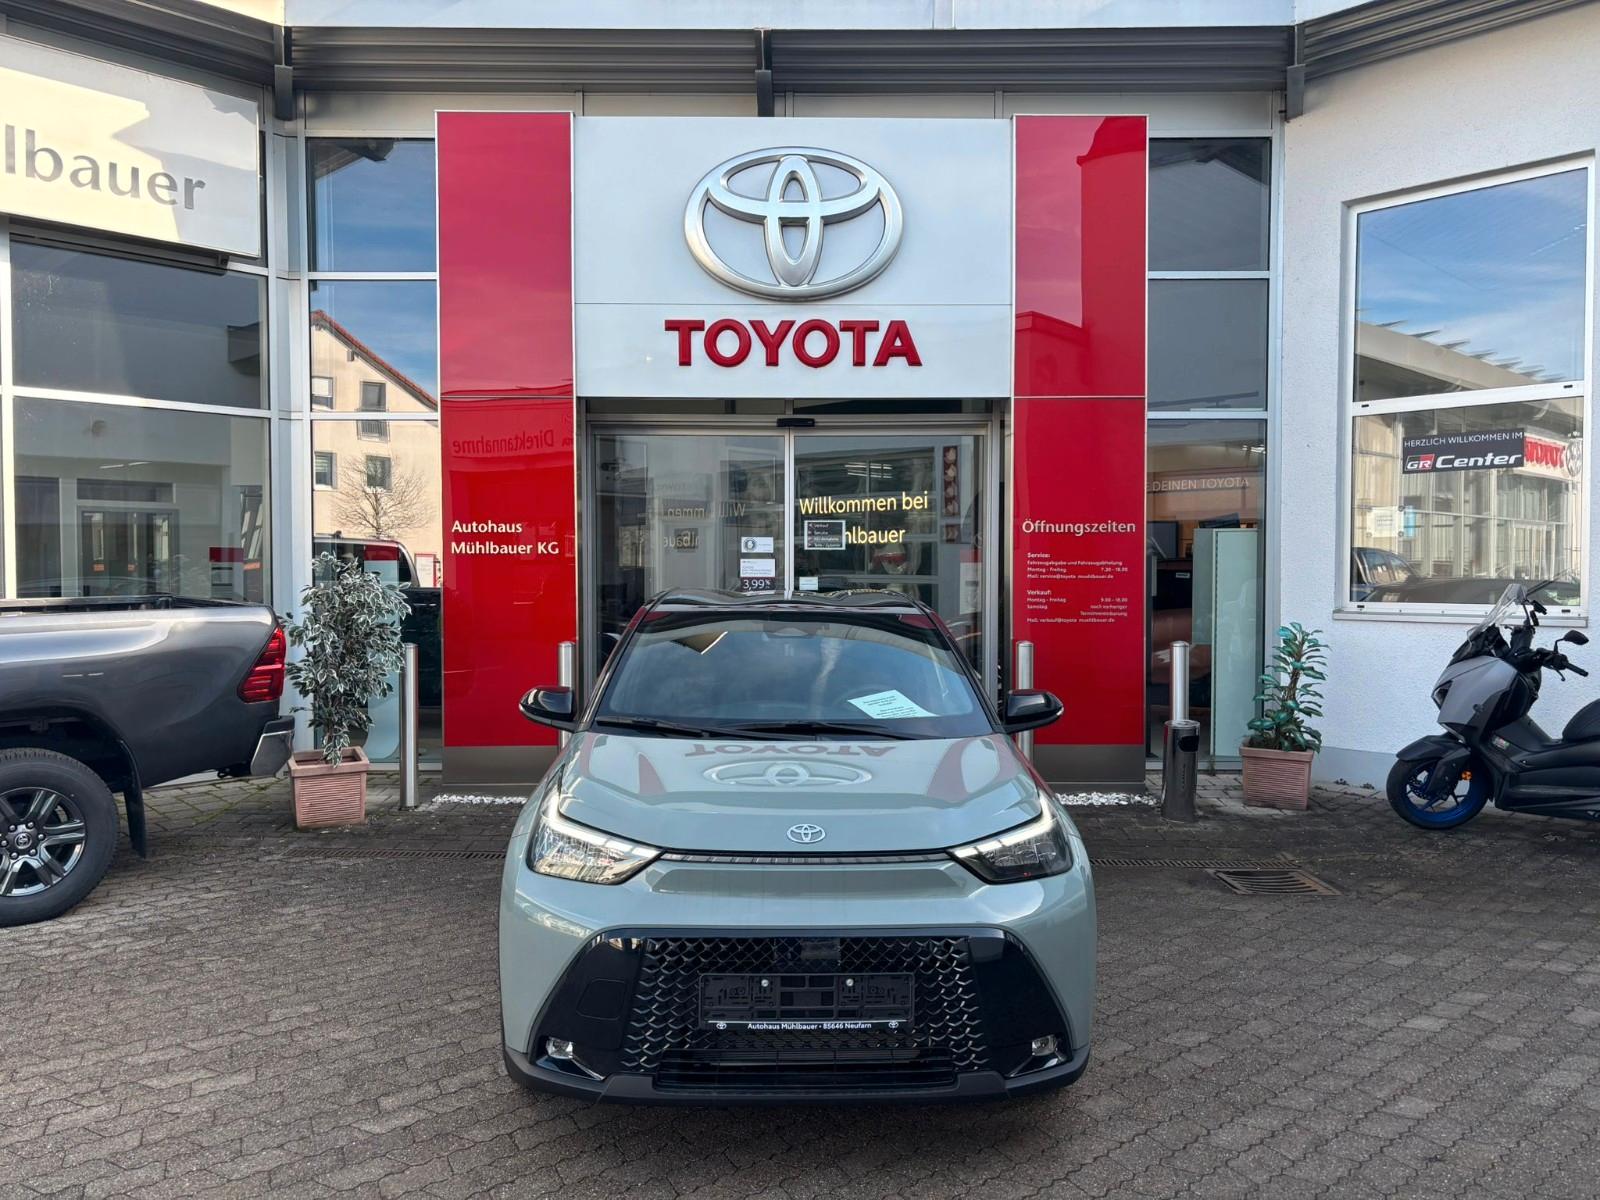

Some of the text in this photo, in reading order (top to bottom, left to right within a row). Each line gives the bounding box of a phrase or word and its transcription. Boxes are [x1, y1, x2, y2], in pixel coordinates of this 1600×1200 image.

[5, 123, 206, 210] lbauer
[665, 318, 922, 368] TOYOTA
[1404, 432, 1523, 448] HERZLICH WILLKOMMEN IM
[1405, 457, 1434, 470] GR
[1436, 453, 1522, 468] Center
[1152, 480, 1196, 491] DEINEN
[1201, 478, 1249, 488] TOYOTA
[800, 491, 928, 514] Willkommen bei
[452, 520, 522, 533] Autohaus
[1022, 518, 1136, 536] Öffnungszeiten
[451, 540, 559, 554] Mühlbauer KG
[781, 1022, 818, 1030] Mühlbauer
